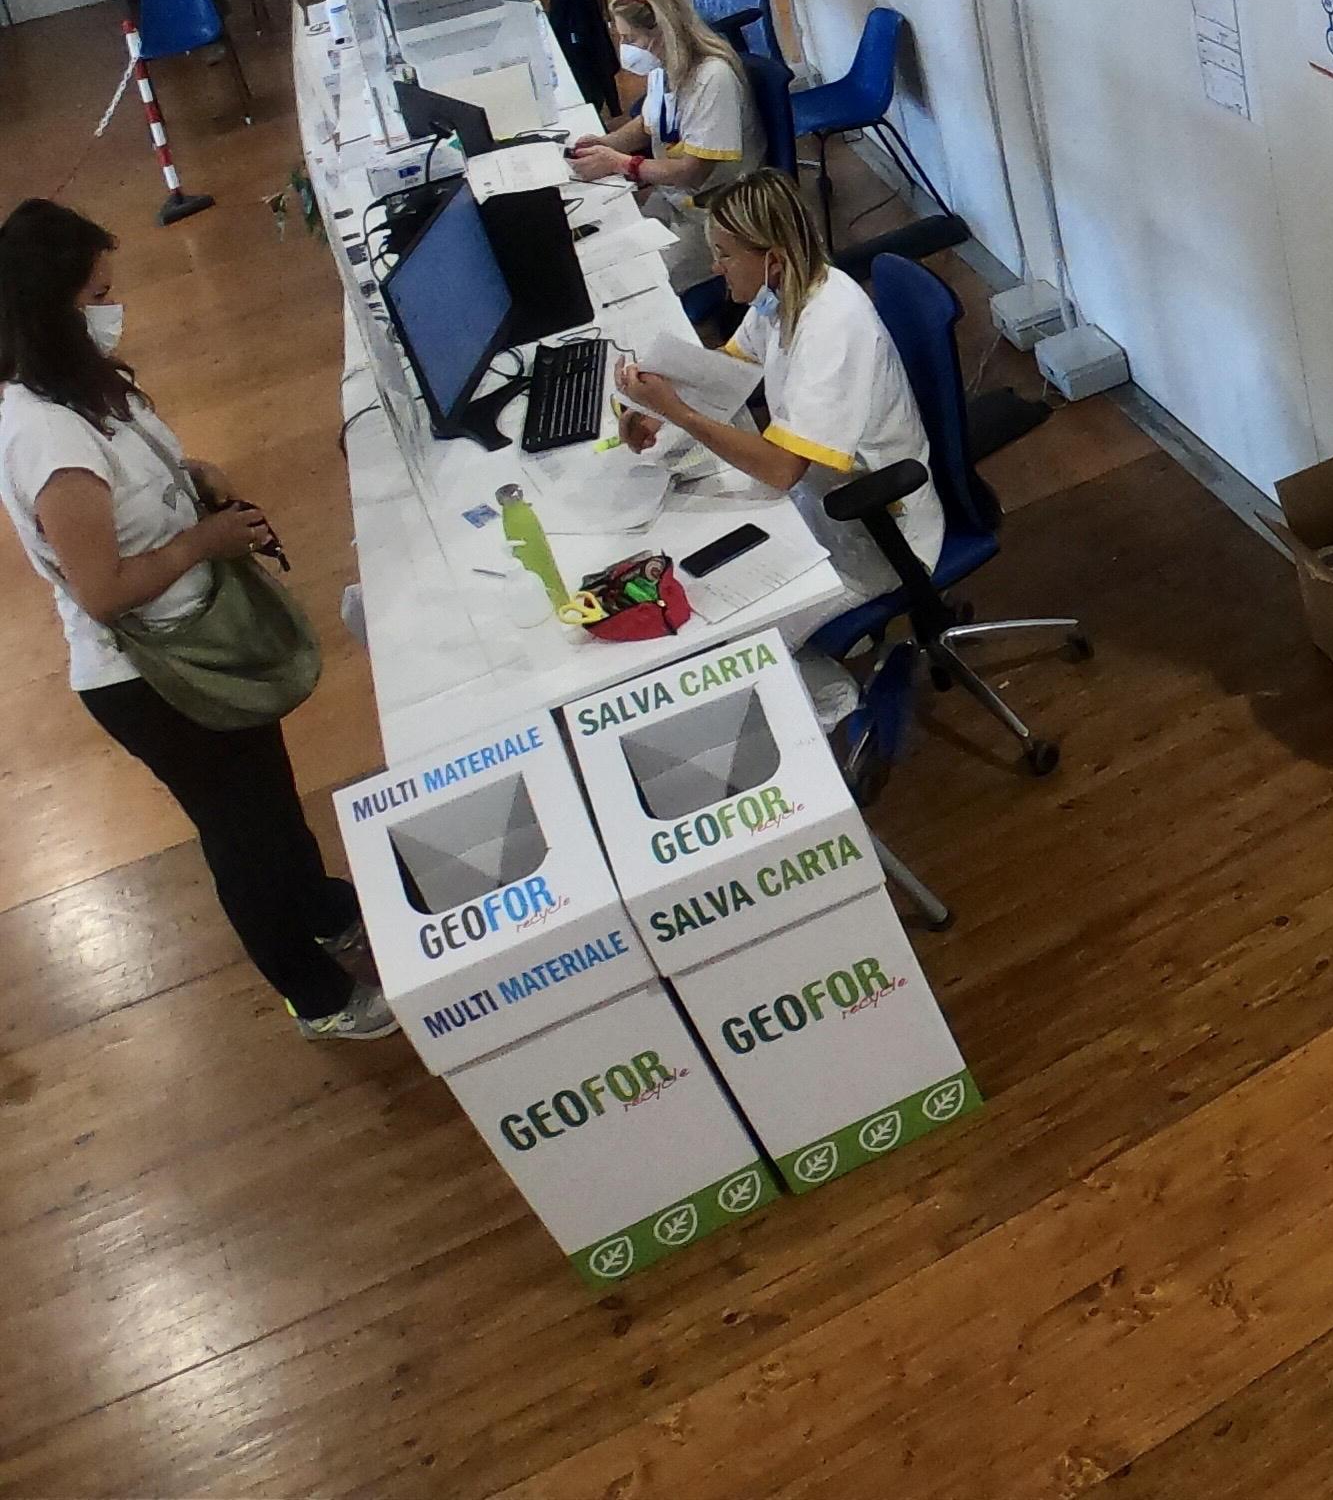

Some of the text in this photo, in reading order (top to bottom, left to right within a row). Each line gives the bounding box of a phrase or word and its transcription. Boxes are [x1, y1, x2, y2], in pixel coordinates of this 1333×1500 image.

[577, 643, 778, 736] SALVA CARTA
[352, 726, 544, 823] MULTI MATERIALE
[650, 784, 806, 865] GEOFOR recycle
[419, 874, 571, 960] GEOFOR recycle
[649, 833, 863, 944] SALVA CARTA
[423, 929, 629, 1039] MULTI MATERIALE
[721, 956, 909, 1055] GEOFOR recycle
[499, 1048, 690, 1153] GEOFOR recycle
